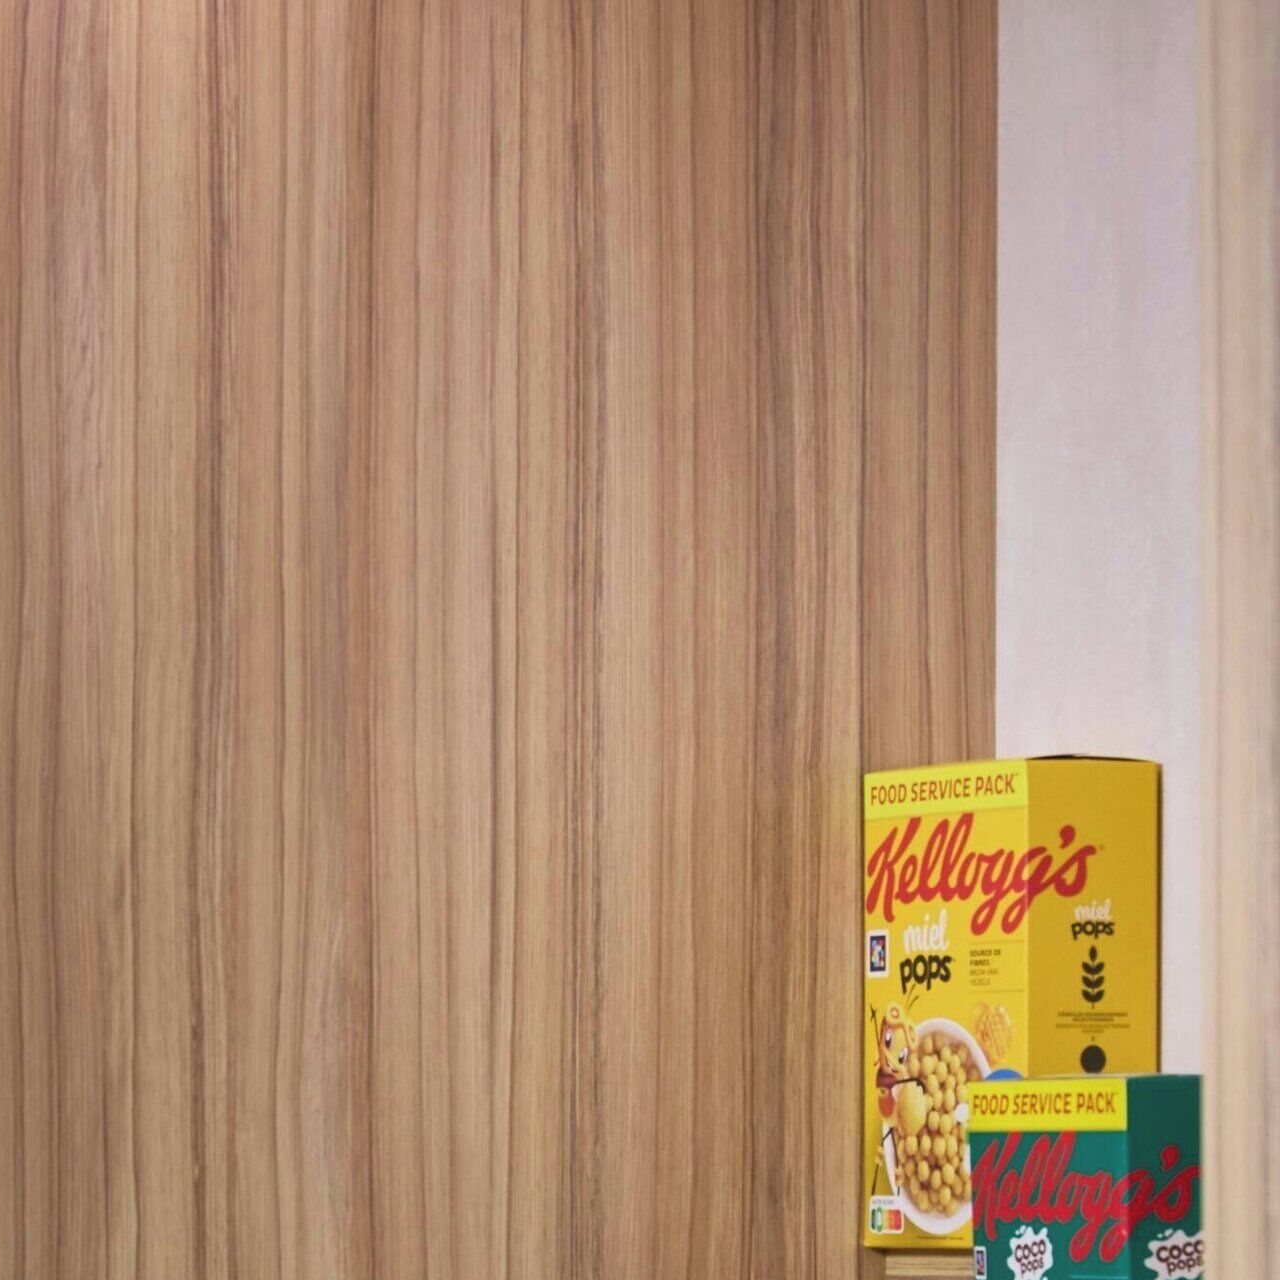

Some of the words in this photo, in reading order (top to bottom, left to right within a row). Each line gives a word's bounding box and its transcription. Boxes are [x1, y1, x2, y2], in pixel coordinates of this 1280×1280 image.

[870, 783, 907, 806] FOOD
[911, 776, 971, 803] SERVICE
[975, 774, 1015, 795] PACK
[865, 812, 1098, 936] Kellogg's
[904, 909, 950, 955] miel
[1071, 920, 1115, 941] pops
[900, 954, 952, 994] pops
[973, 1093, 1009, 1115] FOOD
[1012, 1092, 1072, 1115] SERVICE
[1075, 1091, 1115, 1113] PACK
[971, 1131, 1202, 1263] Kellogg's
